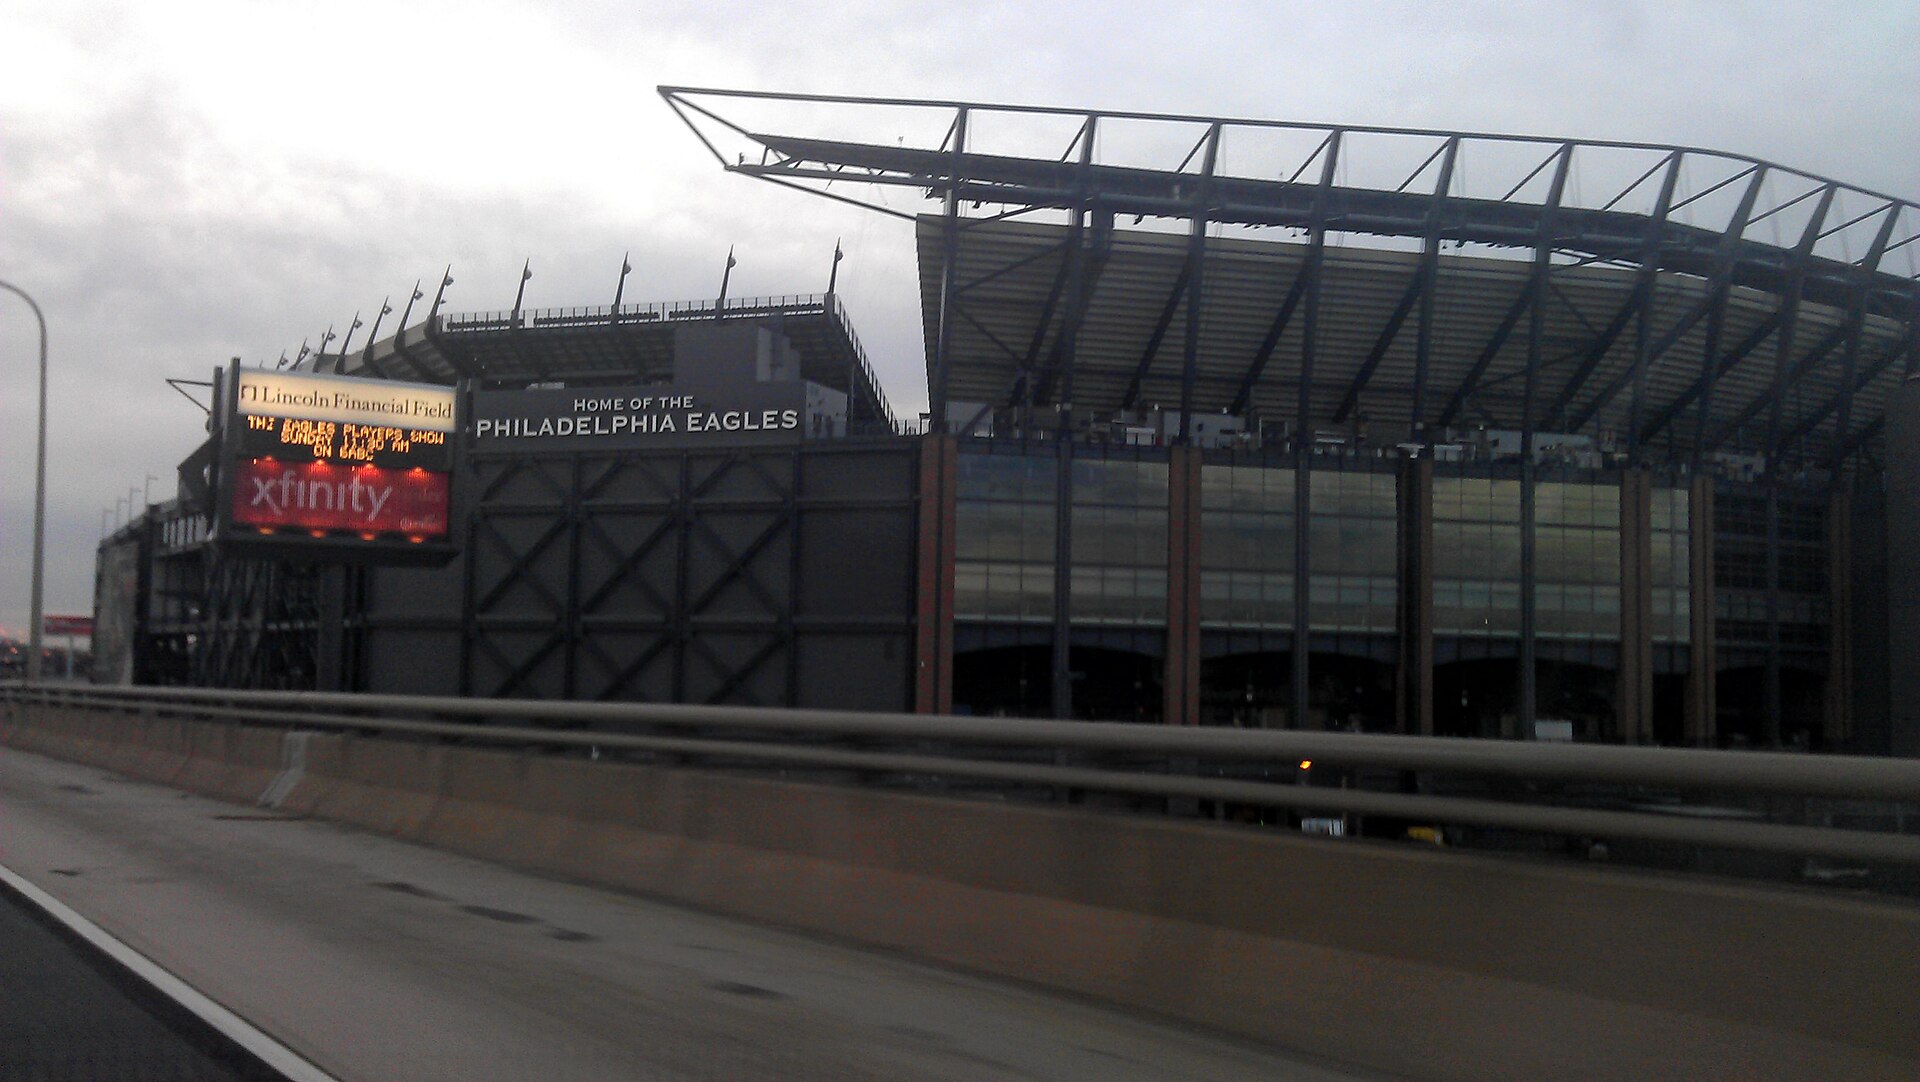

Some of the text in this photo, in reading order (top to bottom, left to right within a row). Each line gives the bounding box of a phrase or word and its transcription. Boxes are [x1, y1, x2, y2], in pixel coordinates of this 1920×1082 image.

[262, 385, 451, 419] Lincoln Financial Field
[574, 396, 694, 412] HOME OF THE
[283, 417, 335, 436] EAGLES
[343, 423, 403, 441] PLAYERS
[410, 429, 445, 445] SHOW
[476, 409, 798, 438] PHILADELPHIA EAGLES
[281, 431, 334, 446] SUNDAY
[392, 440, 410, 453] AM
[313, 444, 332, 458] ON
[250, 470, 393, 522] xfinity
